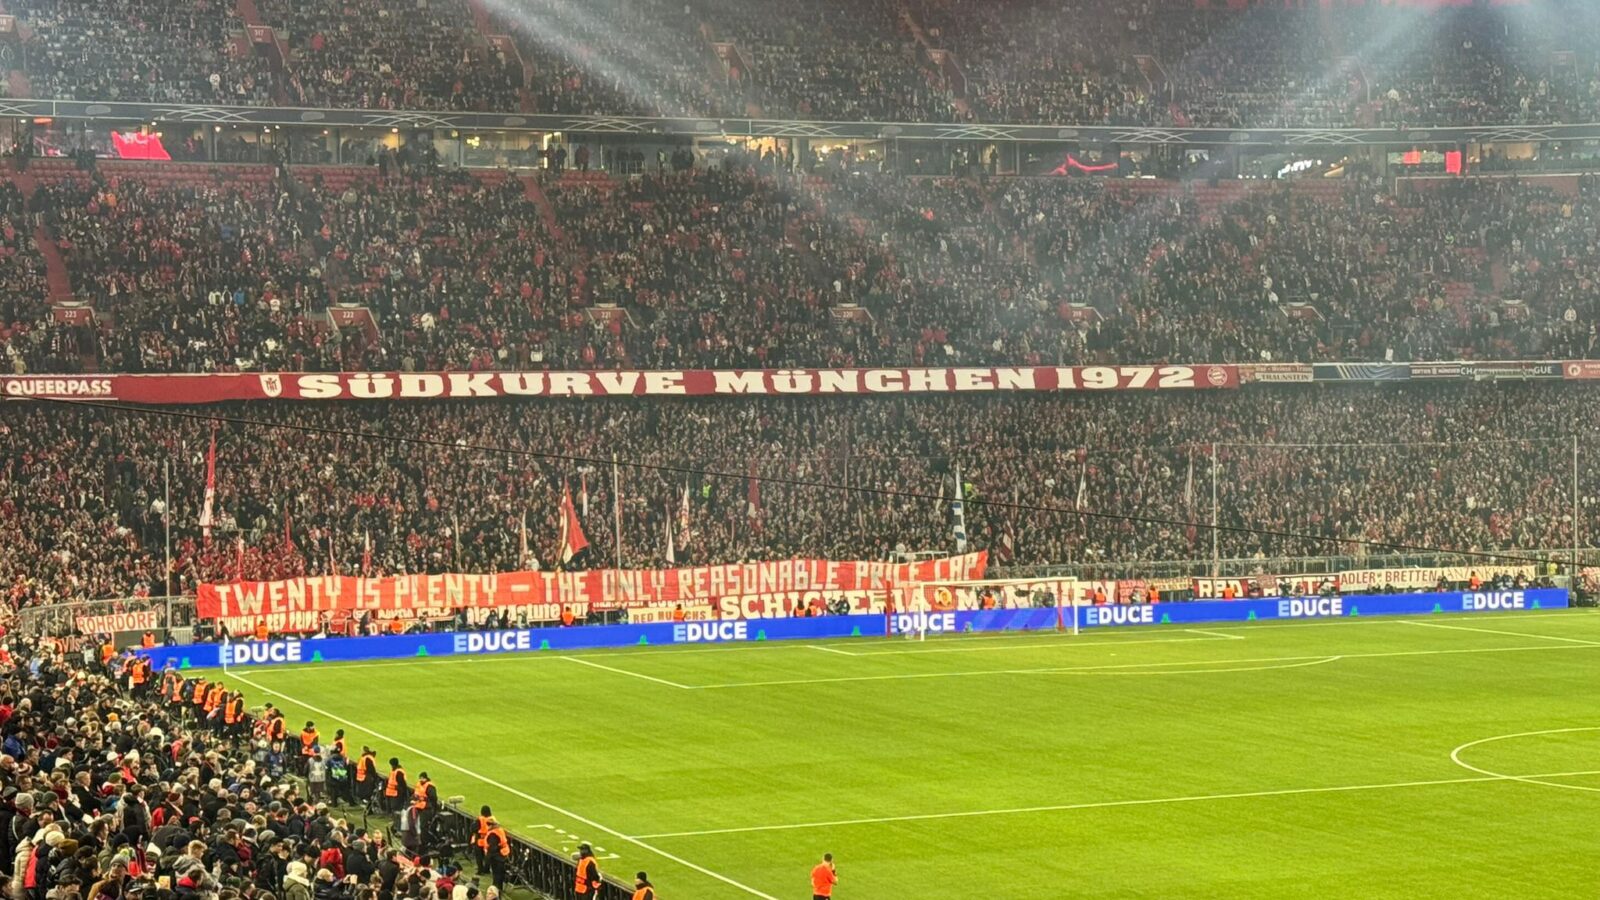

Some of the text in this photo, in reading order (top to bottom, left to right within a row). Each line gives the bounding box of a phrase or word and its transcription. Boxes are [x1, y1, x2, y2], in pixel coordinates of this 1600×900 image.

[6, 379, 112, 395] QUEERPASS
[714, 368, 1037, 394] MÜNCHEN
[1055, 366, 1196, 390] 1972
[214, 576, 342, 617] TWENTY
[356, 577, 381, 609] IS
[395, 573, 498, 609] PLENTY
[541, 570, 590, 603] THE
[602, 569, 666, 602] ONLY
[678, 560, 840, 599] REASONABLE
[934, 552, 977, 581] CAP
[1340, 568, 1438, 585] ADLER BRETTEN
[1278, 598, 1343, 617] EDUCE
[1462, 591, 1524, 610] EDUCE
[77, 612, 156, 634] ROHRDORF
[633, 610, 706, 624] RED MUCHS
[1086, 605, 1153, 624] EDUCE
[454, 630, 531, 653] EDUCE
[673, 621, 747, 643] EDUCE
[219, 641, 301, 664] EDUCE
